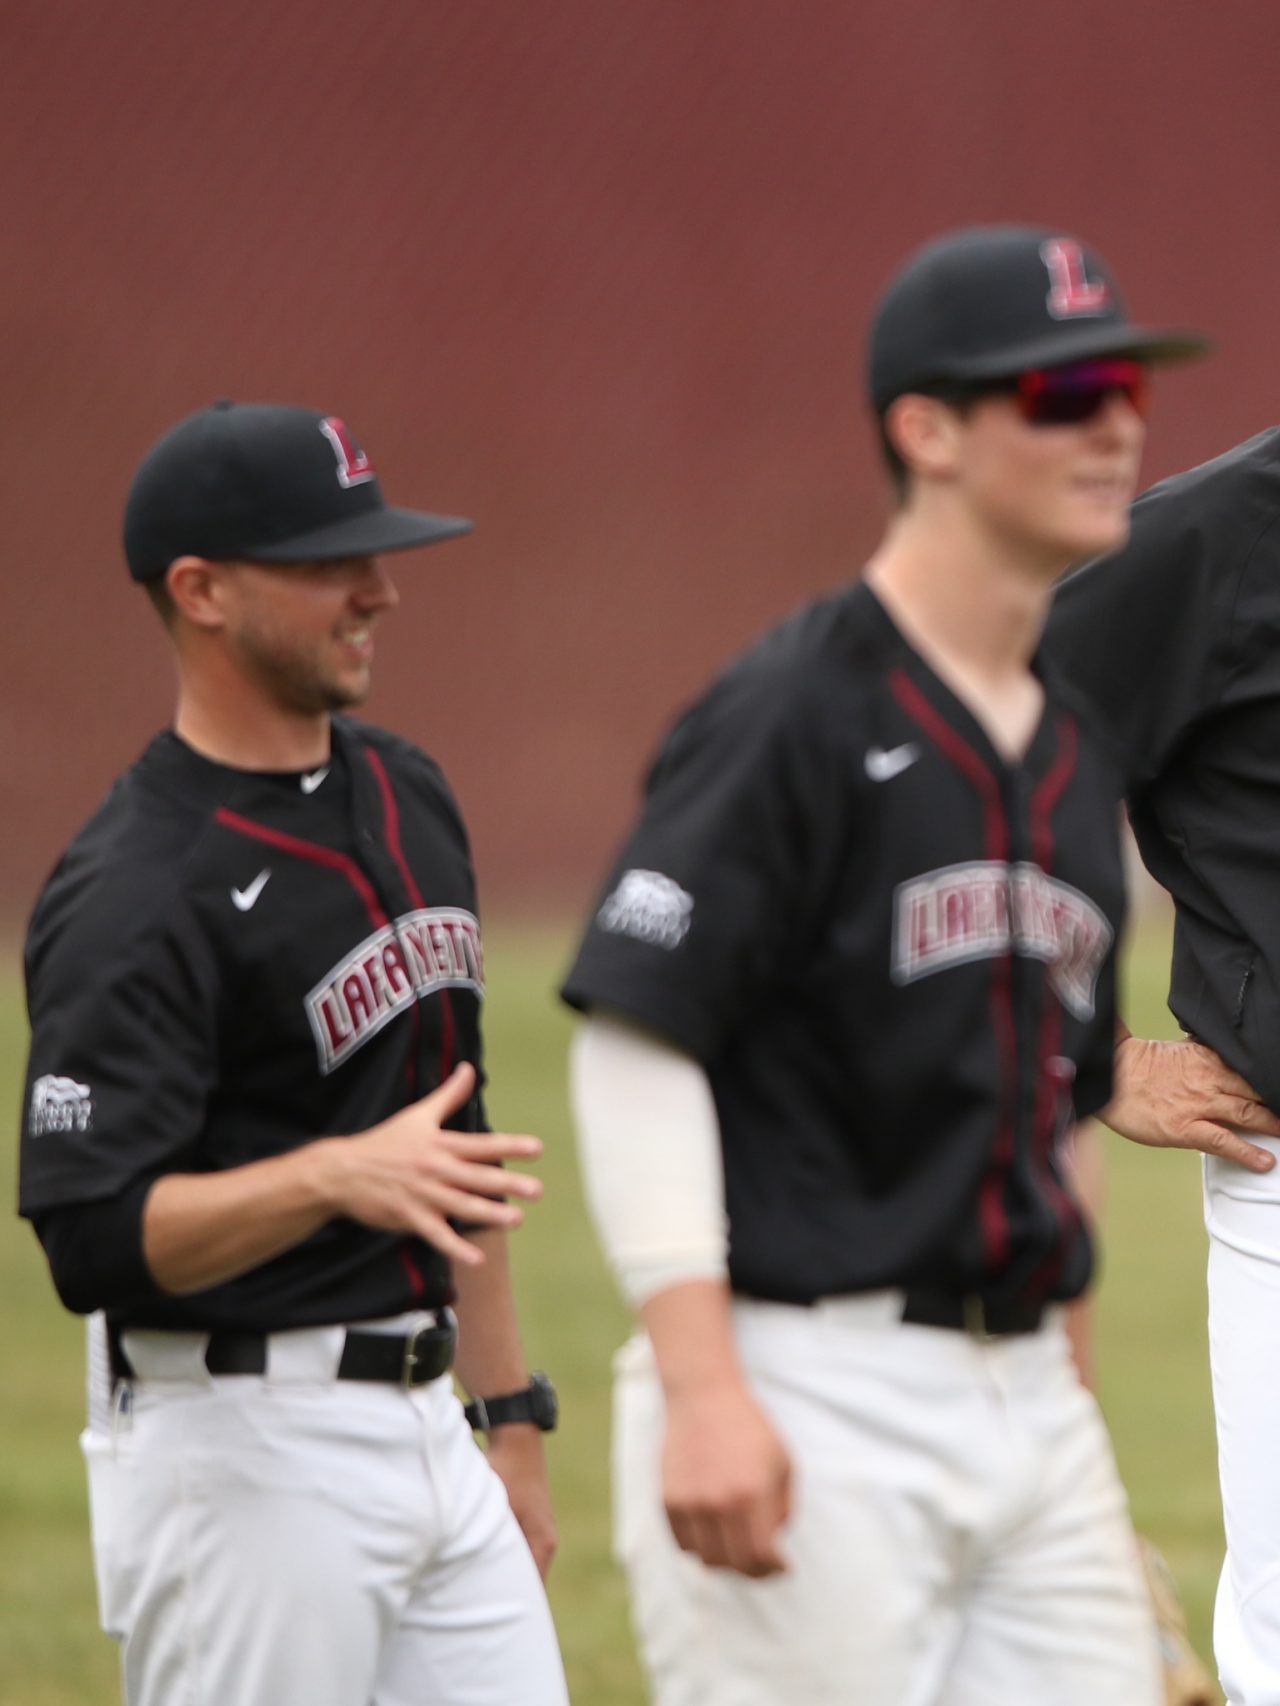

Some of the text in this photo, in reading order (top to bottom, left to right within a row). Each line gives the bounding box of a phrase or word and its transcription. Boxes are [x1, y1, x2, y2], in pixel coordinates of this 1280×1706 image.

[1039, 238, 1111, 320] L
[319, 416, 376, 488] L
[305, 910, 487, 1072] LAFAYETT
